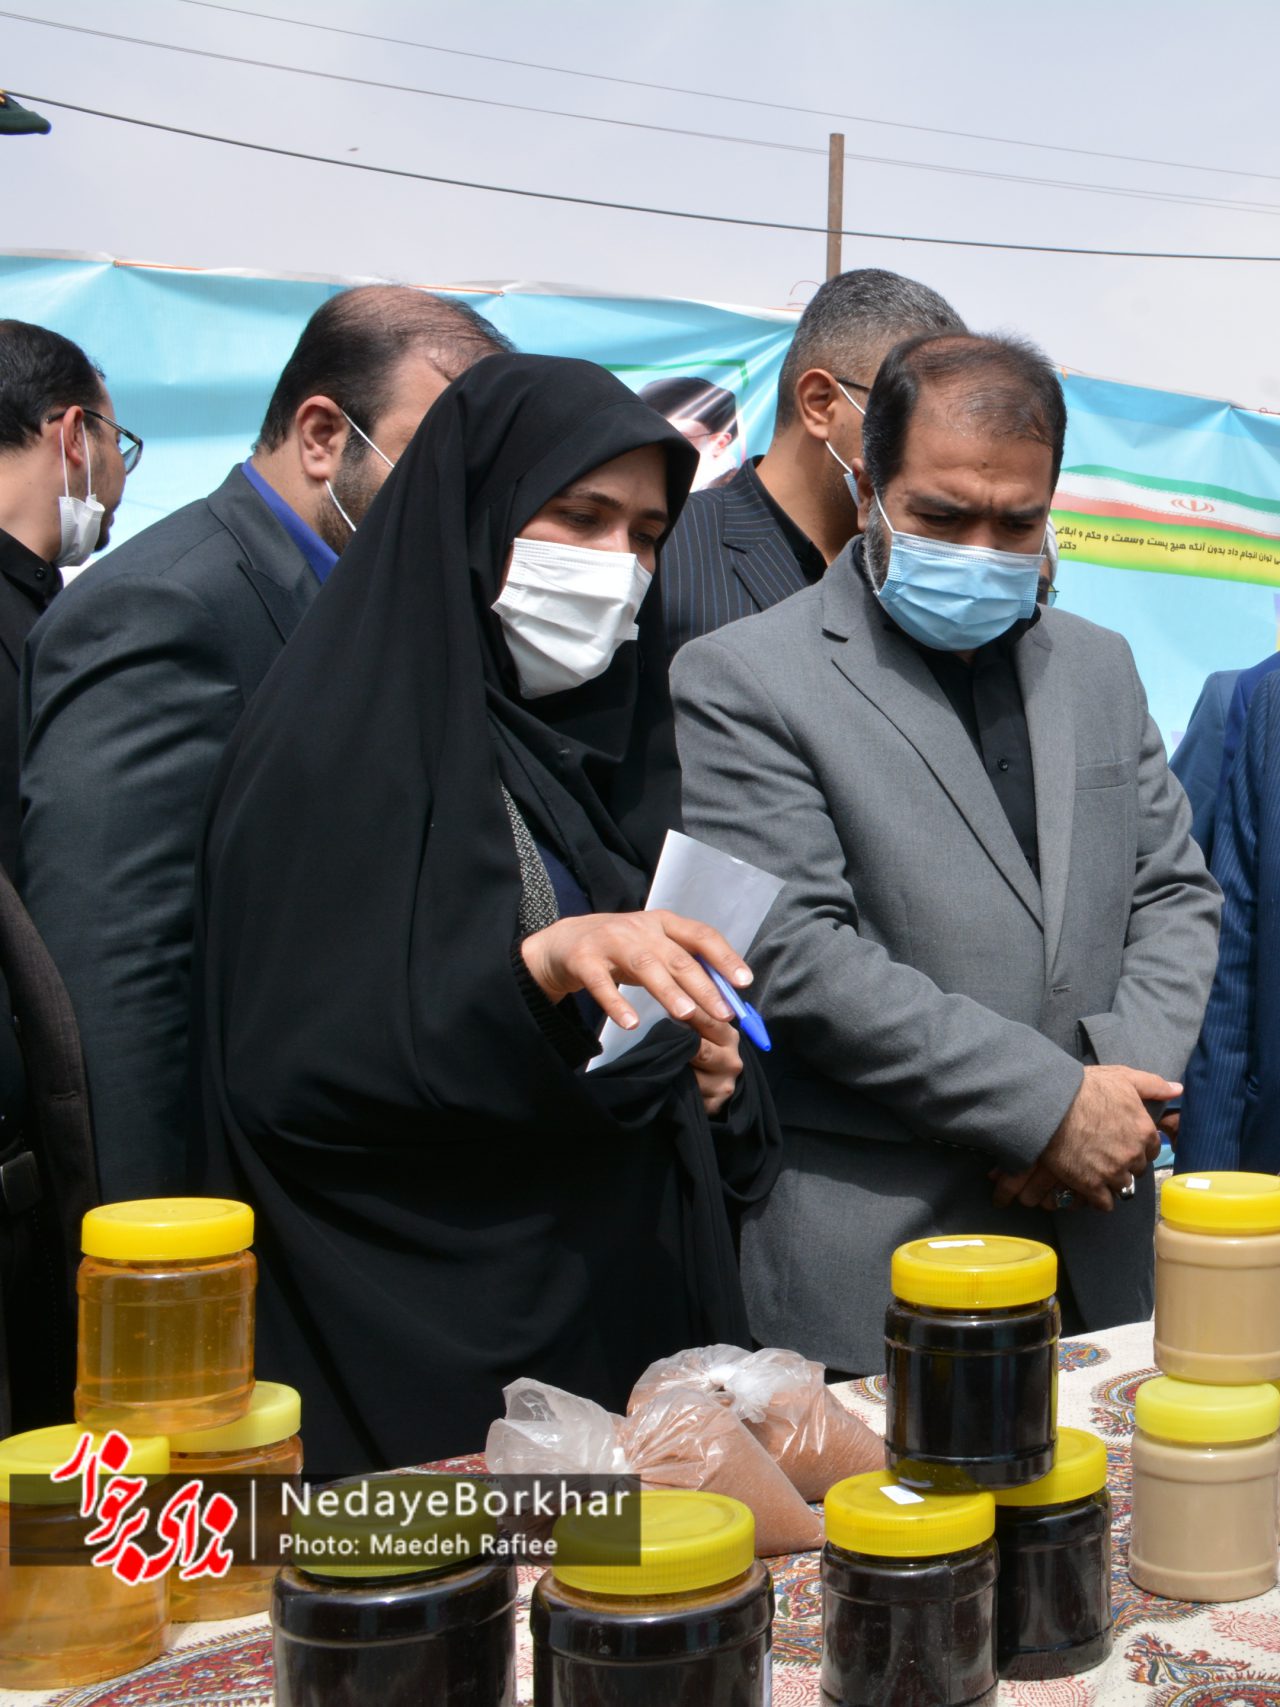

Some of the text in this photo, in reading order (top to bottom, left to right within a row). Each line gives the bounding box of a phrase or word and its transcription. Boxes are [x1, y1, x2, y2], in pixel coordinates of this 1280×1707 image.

[1078, 530, 1083, 538] و
[1085, 531, 1101, 541] حکم
[1058, 541, 1077, 550] دکتر
[1147, 537, 1168, 549] پست
[1170, 542, 1186, 552] هیچ
[1189, 542, 1205, 551] آنکه
[1207, 545, 1225, 555] بدون
[1228, 548, 1239, 556] داد
[1240, 551, 1257, 560] انجام
[1259, 553, 1273, 562] توان
